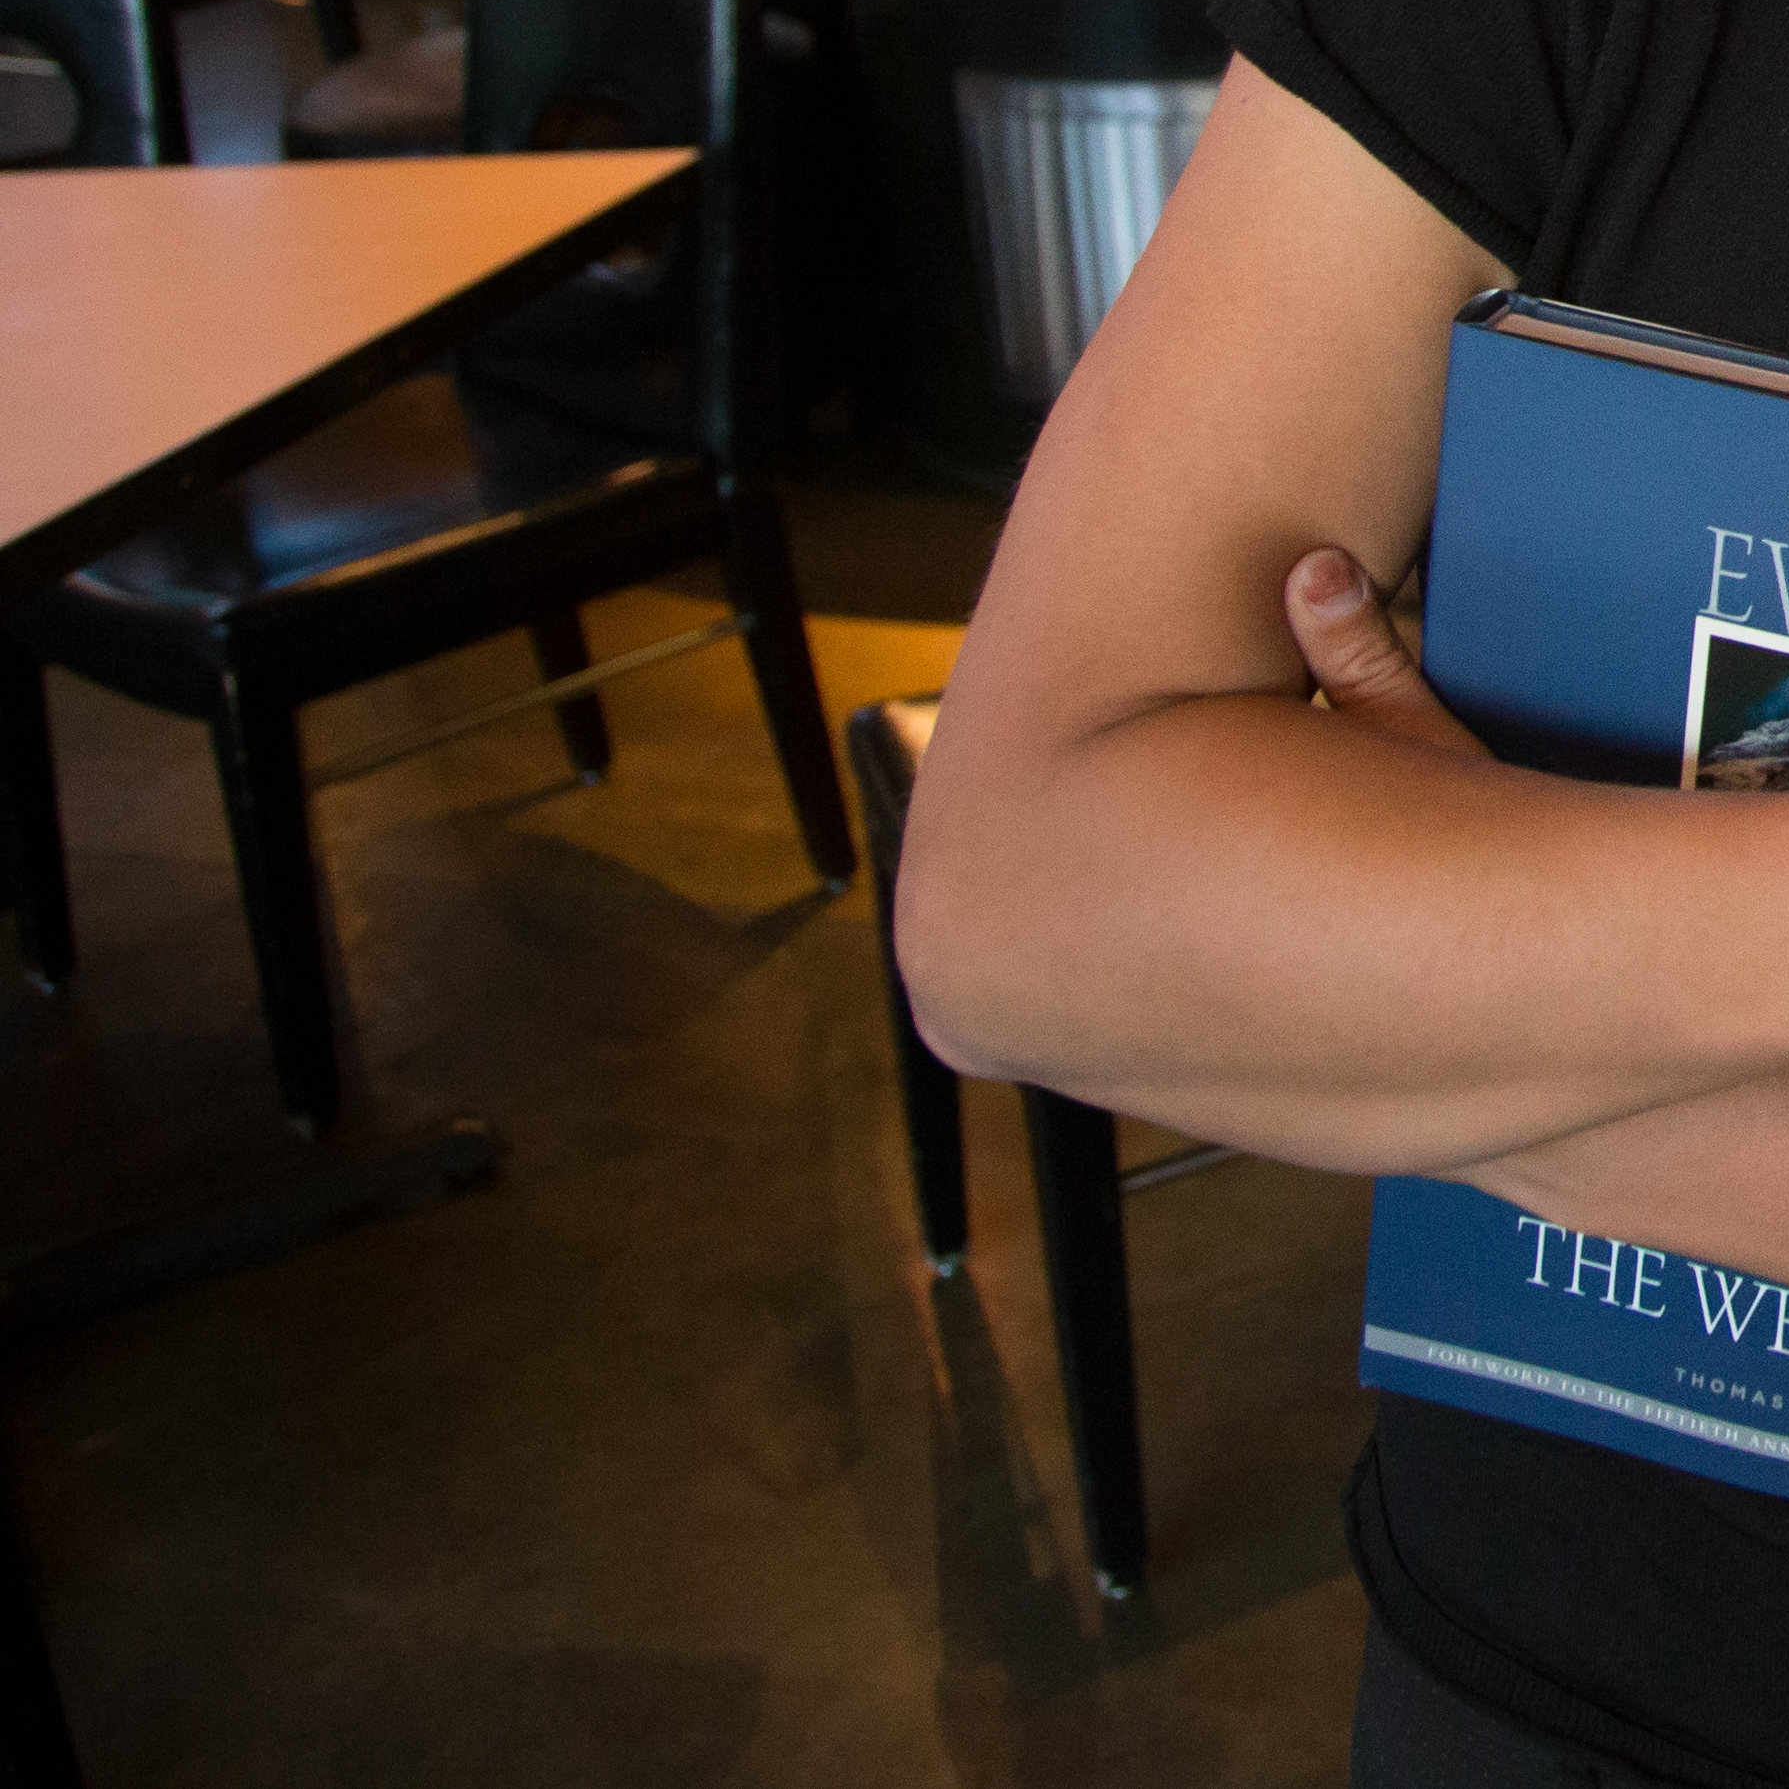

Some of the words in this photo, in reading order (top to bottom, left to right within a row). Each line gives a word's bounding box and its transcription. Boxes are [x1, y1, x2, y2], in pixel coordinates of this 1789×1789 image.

[1517, 1214, 1667, 1319] THE
[1427, 1345, 1550, 1387] FOREWORD
[1560, 1378, 1587, 1397] TO
[1597, 1389, 1632, 1411] THE
[1644, 1403, 1739, 1443] FIFTIETH
[1674, 1365, 1785, 1411] THOMAS
